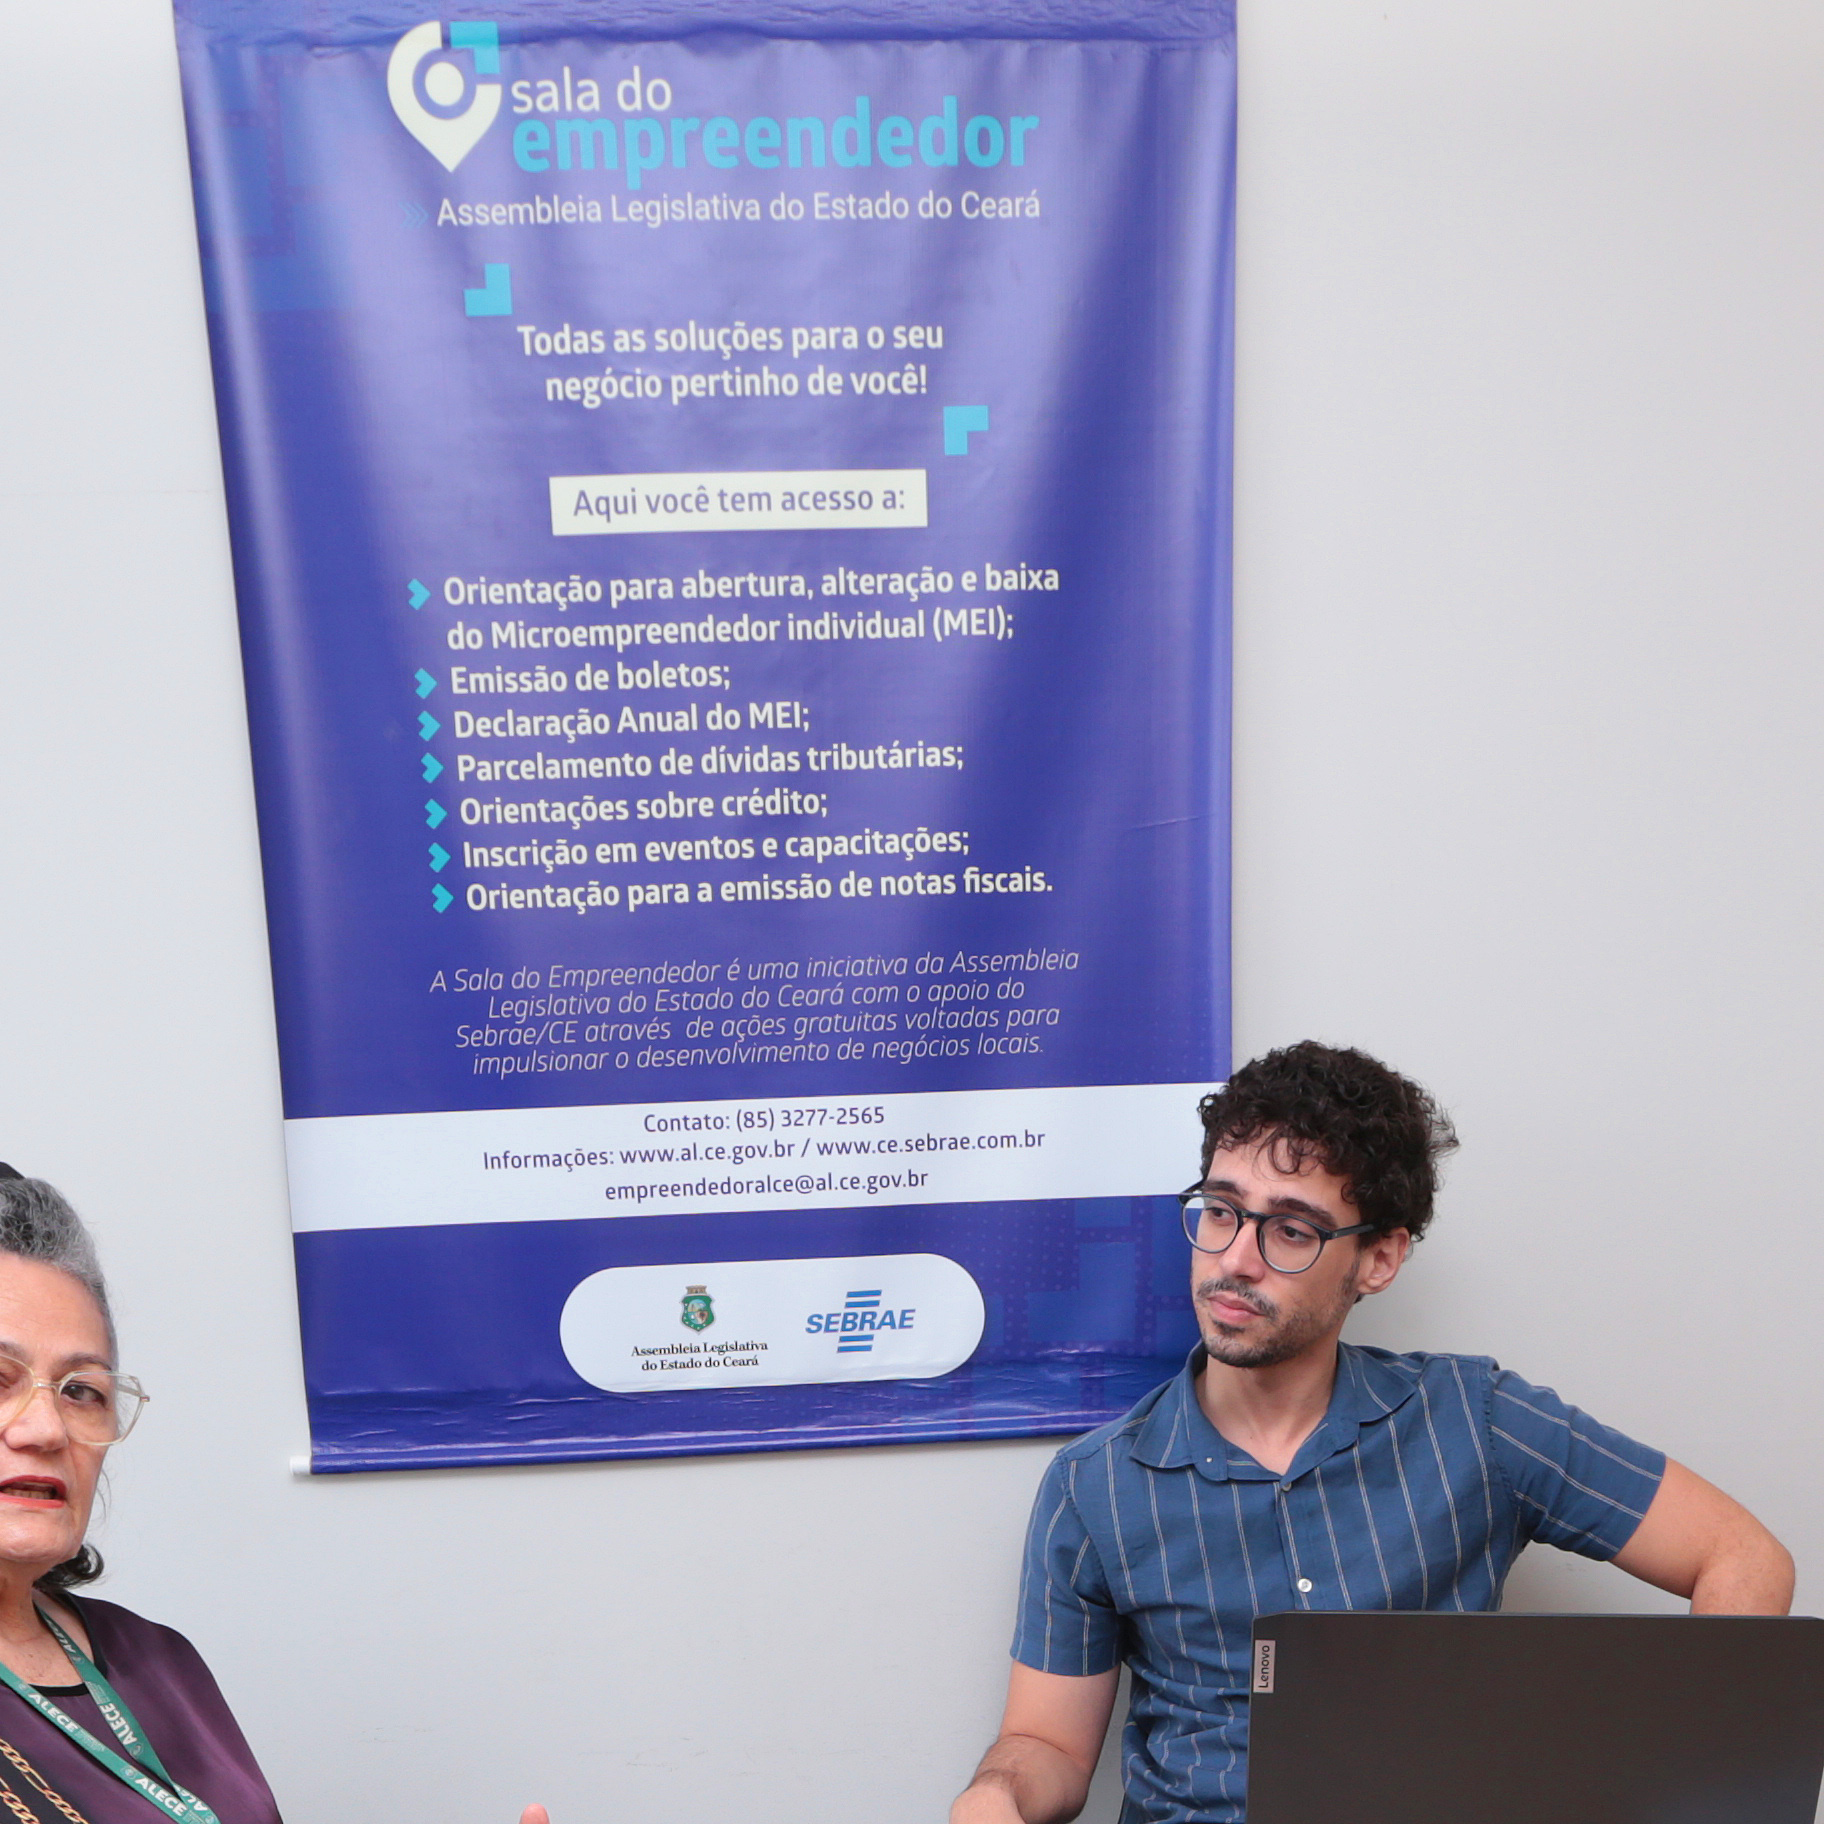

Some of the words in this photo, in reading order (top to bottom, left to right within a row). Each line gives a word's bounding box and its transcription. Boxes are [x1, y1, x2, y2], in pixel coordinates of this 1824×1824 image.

[511, 65, 600, 114] sala
[616, 65, 672, 112] do
[512, 94, 1041, 190] empreendedor
[437, 194, 602, 227] Assembleia
[610, 191, 761, 229] Legislativa
[769, 191, 805, 221] do
[813, 190, 910, 220] Estado
[917, 189, 953, 219] do
[961, 188, 1040, 220] Ceará
[516, 323, 606, 356] Todas
[613, 328, 647, 353] as
[654, 319, 783, 360] soluções
[791, 326, 859, 359] para
[866, 325, 885, 350] o
[893, 325, 943, 349] seu
[546, 366, 662, 409] negócio
[670, 365, 799, 406] pertinho
[807, 364, 844, 396] de
[849, 362, 927, 395] você!
[573, 487, 637, 524] Aqui
[645, 485, 710, 514] você
[717, 488, 772, 513] tem
[781, 490, 874, 512] acesso
[882, 489, 905, 510] a:
[444, 574, 602, 612] Orientação
[610, 577, 674, 609] para
[681, 569, 814, 601] abertura,
[821, 565, 954, 603] alteração
[961, 570, 978, 592] e
[985, 562, 1059, 592] baixa
[447, 620, 483, 650] do
[491, 613, 781, 653] Microempreendedor
[787, 609, 925, 641] individual
[932, 605, 1013, 643] (MEI);
[450, 665, 568, 695] Emissão
[575, 662, 610, 692] de
[616, 659, 730, 691] boletos;
[454, 707, 611, 744] Declaração
[616, 702, 698, 734] Anual
[706, 702, 741, 731] do
[749, 701, 809, 732] MEI;
[457, 751, 652, 782] Parcelamento
[659, 747, 694, 776] de
[700, 744, 801, 775] dívidas
[806, 739, 963, 771] tributárias;
[460, 795, 629, 830] Orientações
[636, 790, 715, 820] sobre
[721, 787, 828, 818] crédito;
[463, 838, 588, 874] Inscrição
[595, 842, 638, 864] em
[644, 835, 755, 862] eventos
[762, 837, 778, 858] e
[785, 826, 969, 864] capacitações;
[466, 880, 620, 915] Orientação
[627, 883, 690, 913] para
[696, 882, 713, 903] a
[720, 872, 832, 902] emissão
[839, 870, 873, 898] de
[880, 871, 957, 896] notas
[962, 865, 1053, 894] fiscais.
[429, 970, 447, 993] A
[453, 967, 504, 992] Sala
[511, 965, 541, 990] do
[548, 960, 722, 993] Empreendedor
[727, 958, 741, 982] é
[747, 961, 799, 981] uma
[806, 955, 908, 988] iniciativa
[915, 952, 945, 975] da
[948, 949, 1079, 973] Assembleia
[488, 993, 611, 1025] Legislativa
[618, 990, 647, 1014] do
[654, 986, 734, 1012] Estado
[741, 985, 770, 1009] do
[777, 982, 845, 1008] Ceará
[851, 985, 899, 1005] com
[906, 985, 921, 1003] o
[927, 982, 990, 1008] apoio
[996, 976, 1025, 1000] do
[455, 1020, 579, 1048] Sebrae/CE
[585, 1016, 671, 1043] através
[686, 1015, 714, 1039] de
[721, 1014, 786, 1043] ações
[793, 1012, 898, 1041] gratuitas
[905, 1006, 1000, 1040] voltadas
[1005, 1008, 1060, 1036] para
[473, 1049, 610, 1081] impulsionar
[615, 1051, 629, 1069] o
[636, 1041, 830, 1068] desenvolvimento
[836, 1038, 865, 1061] de
[871, 1038, 971, 1065] negócios
[977, 1034, 1044, 1055] locais.
[643, 1114, 730, 1133] Contato:
[736, 1107, 775, 1133] (85)
[781, 1106, 885, 1128] 3277-2565
[483, 1148, 614, 1173] Informações:
[619, 1138, 796, 1165] www.al.ce.gov.br
[816, 1128, 1046, 1156] www.ce.sebrae.com.br
[605, 1168, 929, 1204] empreendedoralce@al.ce.gov.br
[805, 1308, 916, 1334] SEBRAE
[631, 1344, 701, 1357] Assembleia
[703, 1341, 769, 1355] Legislativa
[642, 1360, 657, 1371] do
[660, 1358, 702, 1371] Estado
[705, 1357, 720, 1369] do
[723, 1355, 759, 1368] Ceará
[1258, 1645, 1270, 1688] Lenovo
[28, 1693, 78, 1732] ALECE
[99, 1702, 138, 1745] ALECE
[135, 1778, 187, 1816] ALECE
